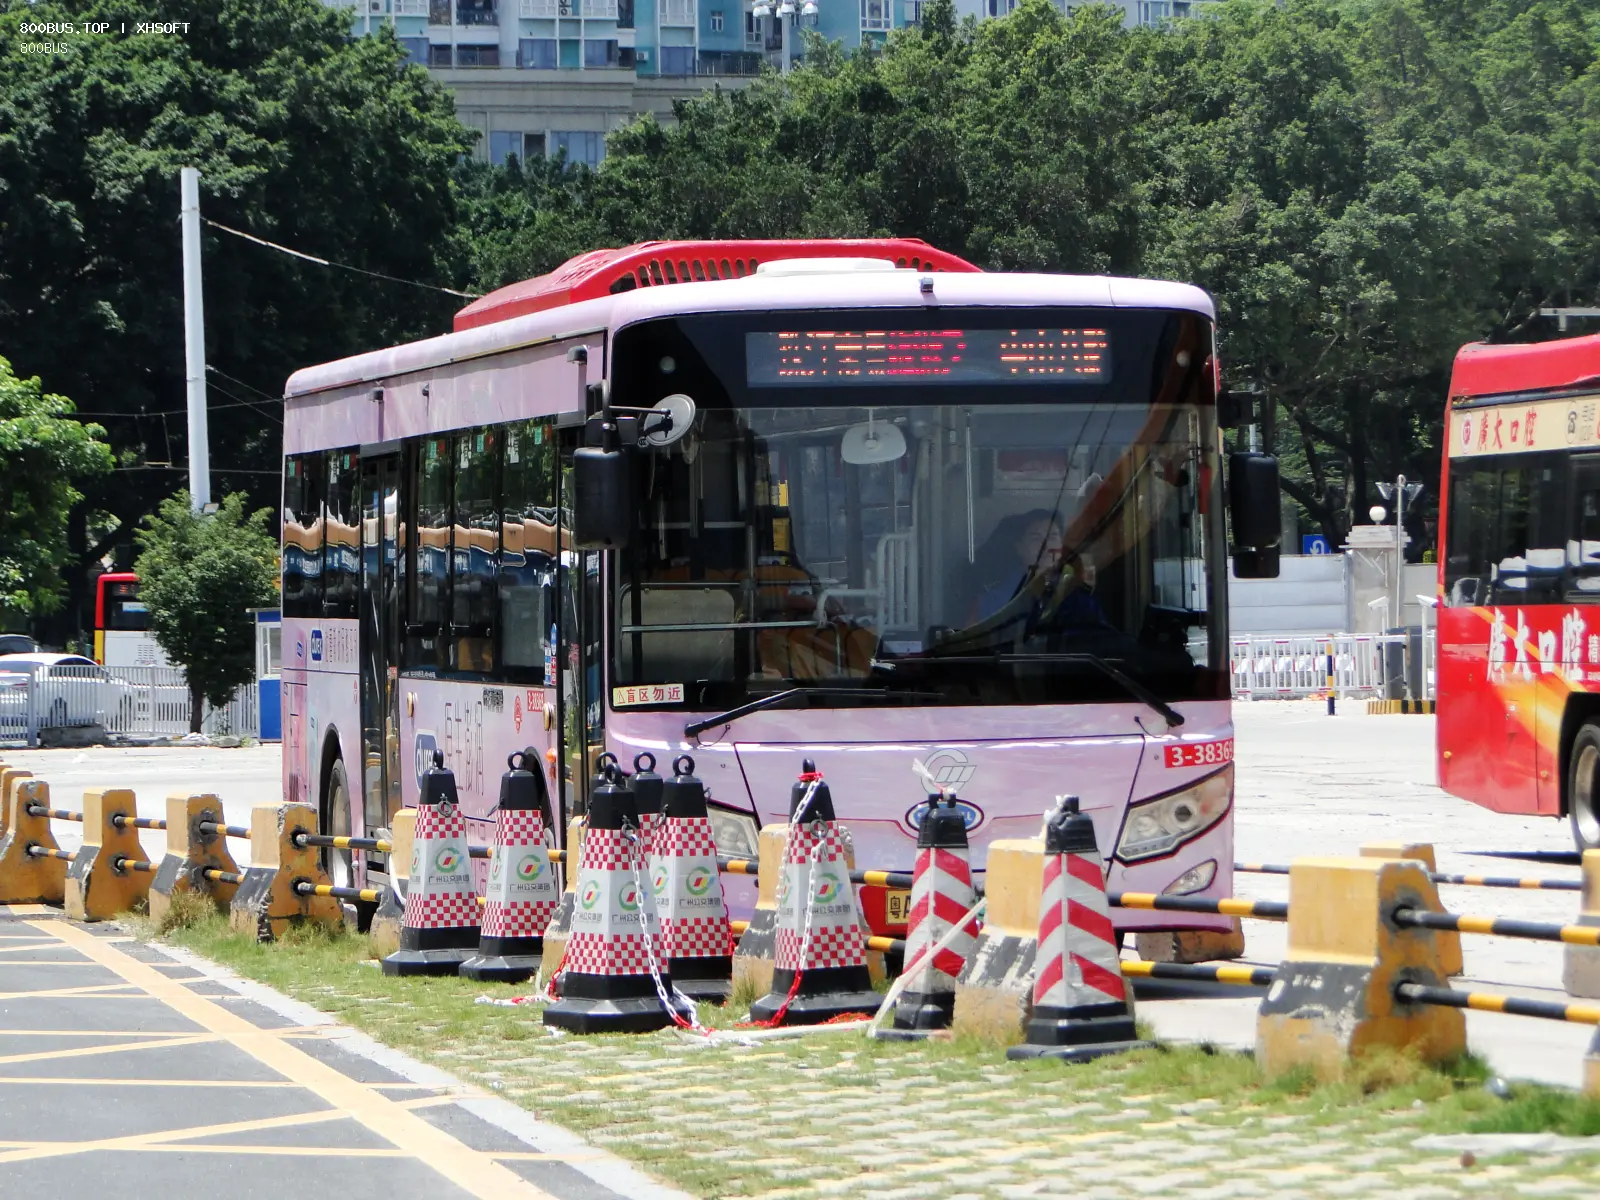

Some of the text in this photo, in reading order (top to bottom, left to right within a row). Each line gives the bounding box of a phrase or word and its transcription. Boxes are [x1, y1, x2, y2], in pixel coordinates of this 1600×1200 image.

[626, 686, 681, 703] 盲区勿近
[509, 883, 551, 893] 广州公交集团
[679, 896, 721, 907] 广州公交集团
[611, 912, 654, 923] 广州公交团
